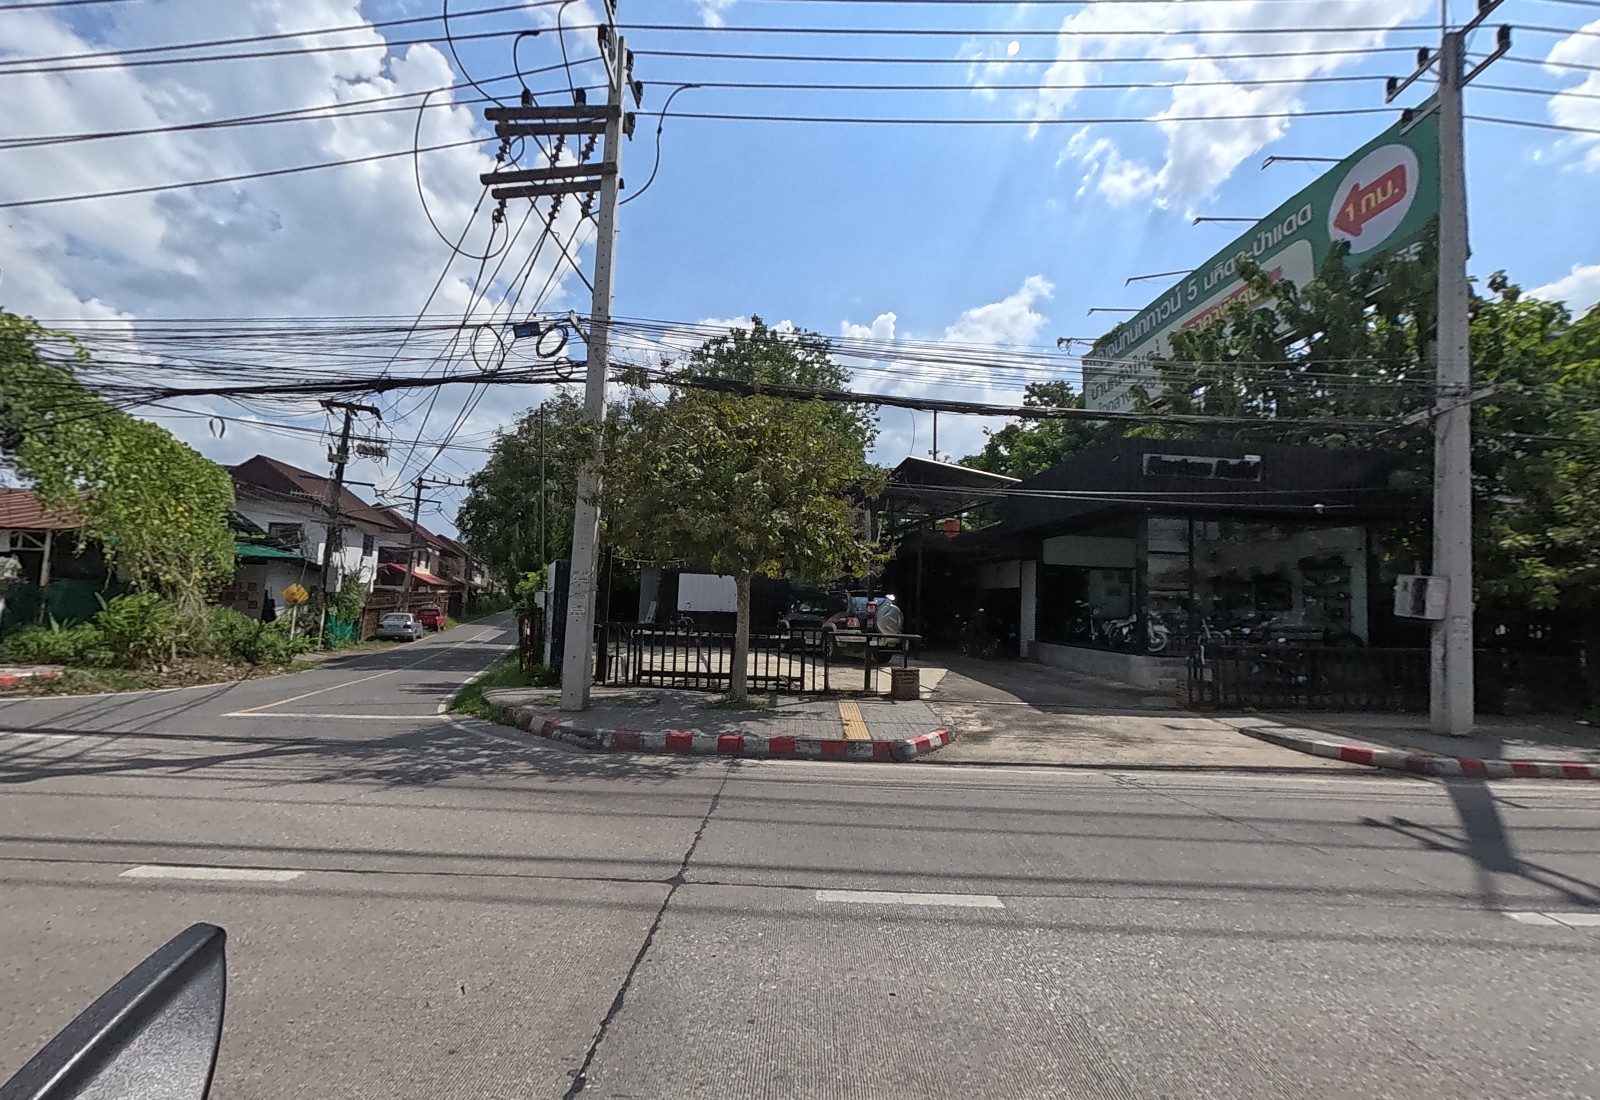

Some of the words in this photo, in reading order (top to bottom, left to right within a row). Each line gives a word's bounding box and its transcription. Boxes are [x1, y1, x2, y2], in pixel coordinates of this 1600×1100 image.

[1344, 202, 1355, 222] 1
[1360, 180, 1400, 215] กม.
[1187, 277, 1198, 302] 5
